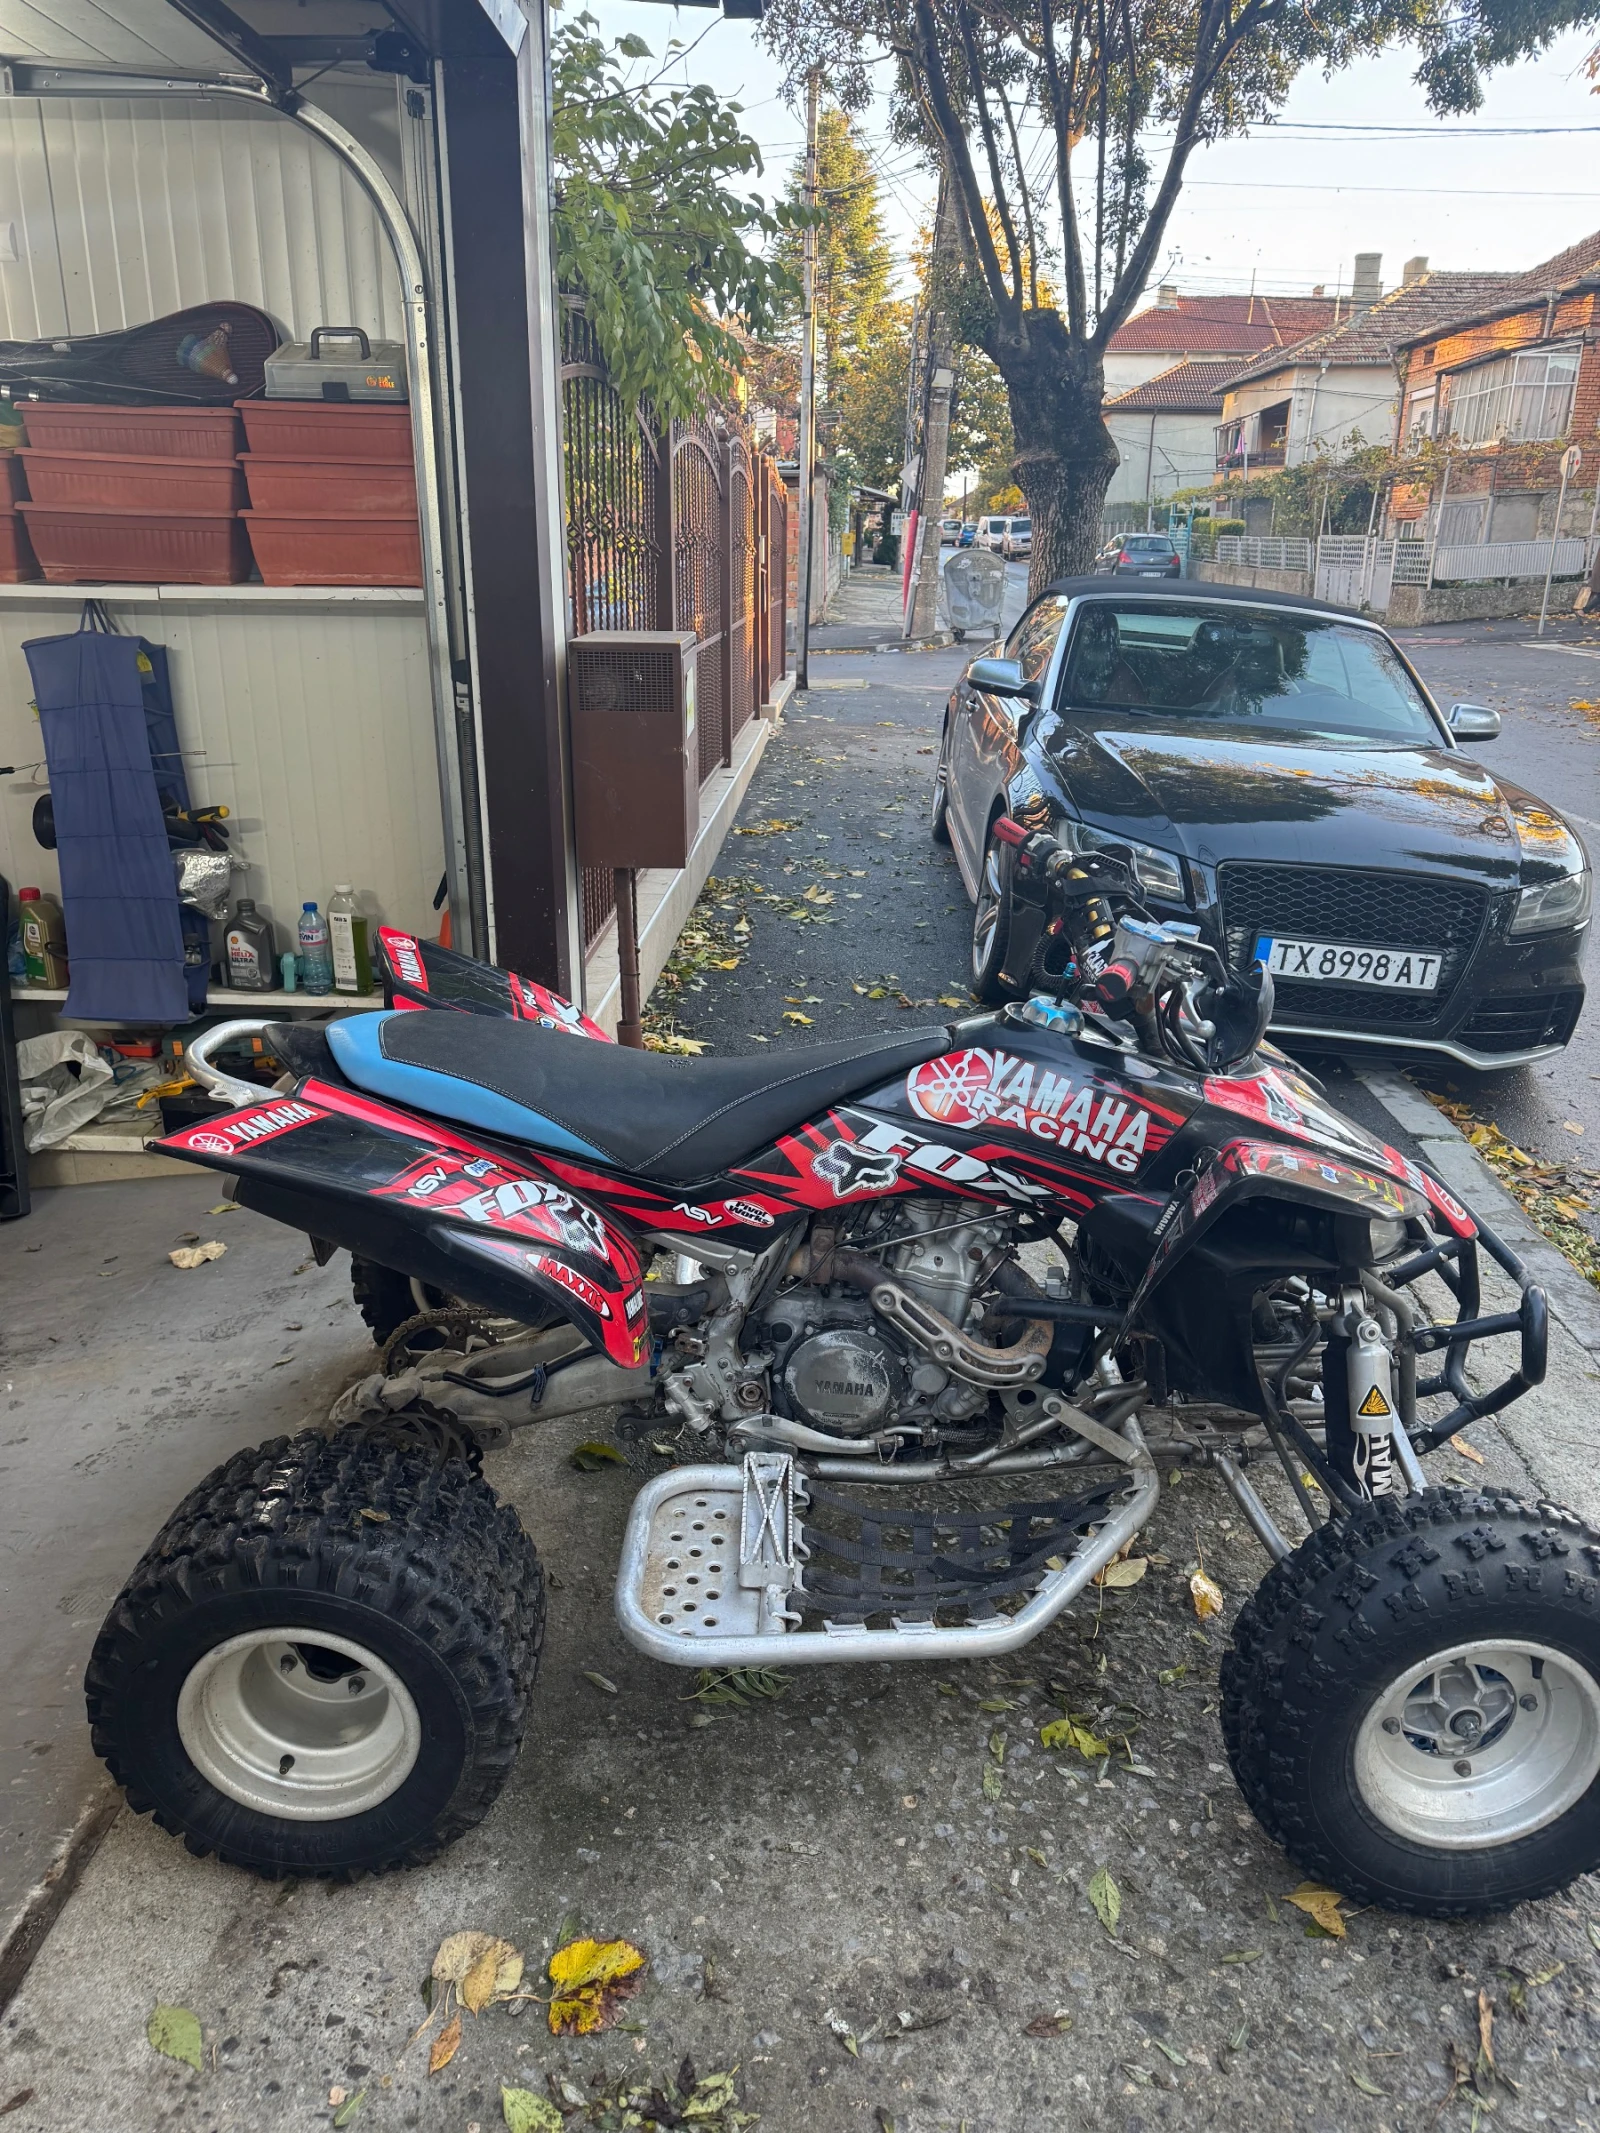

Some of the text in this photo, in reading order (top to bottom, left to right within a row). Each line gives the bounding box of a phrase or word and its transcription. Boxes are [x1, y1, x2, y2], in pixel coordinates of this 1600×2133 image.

[1277, 943, 1437, 985] TX 8998 AT
[223, 1102, 318, 1141] YAMAHA
[985, 1049, 1150, 1155] YAMAHA
[971, 1087, 1141, 1174] RACING
[832, 1105, 1072, 1208] FOX
[407, 1166, 447, 1198] ASV
[430, 1179, 572, 1222] FOX
[672, 1202, 723, 1226] ASV
[728, 1205, 770, 1225] Works
[735, 1200, 769, 1217] Pivot
[1153, 1199, 1180, 1236] YAMAHA
[537, 1256, 606, 1315] MAXXIS
[814, 1379, 874, 1397] YAMAHA
